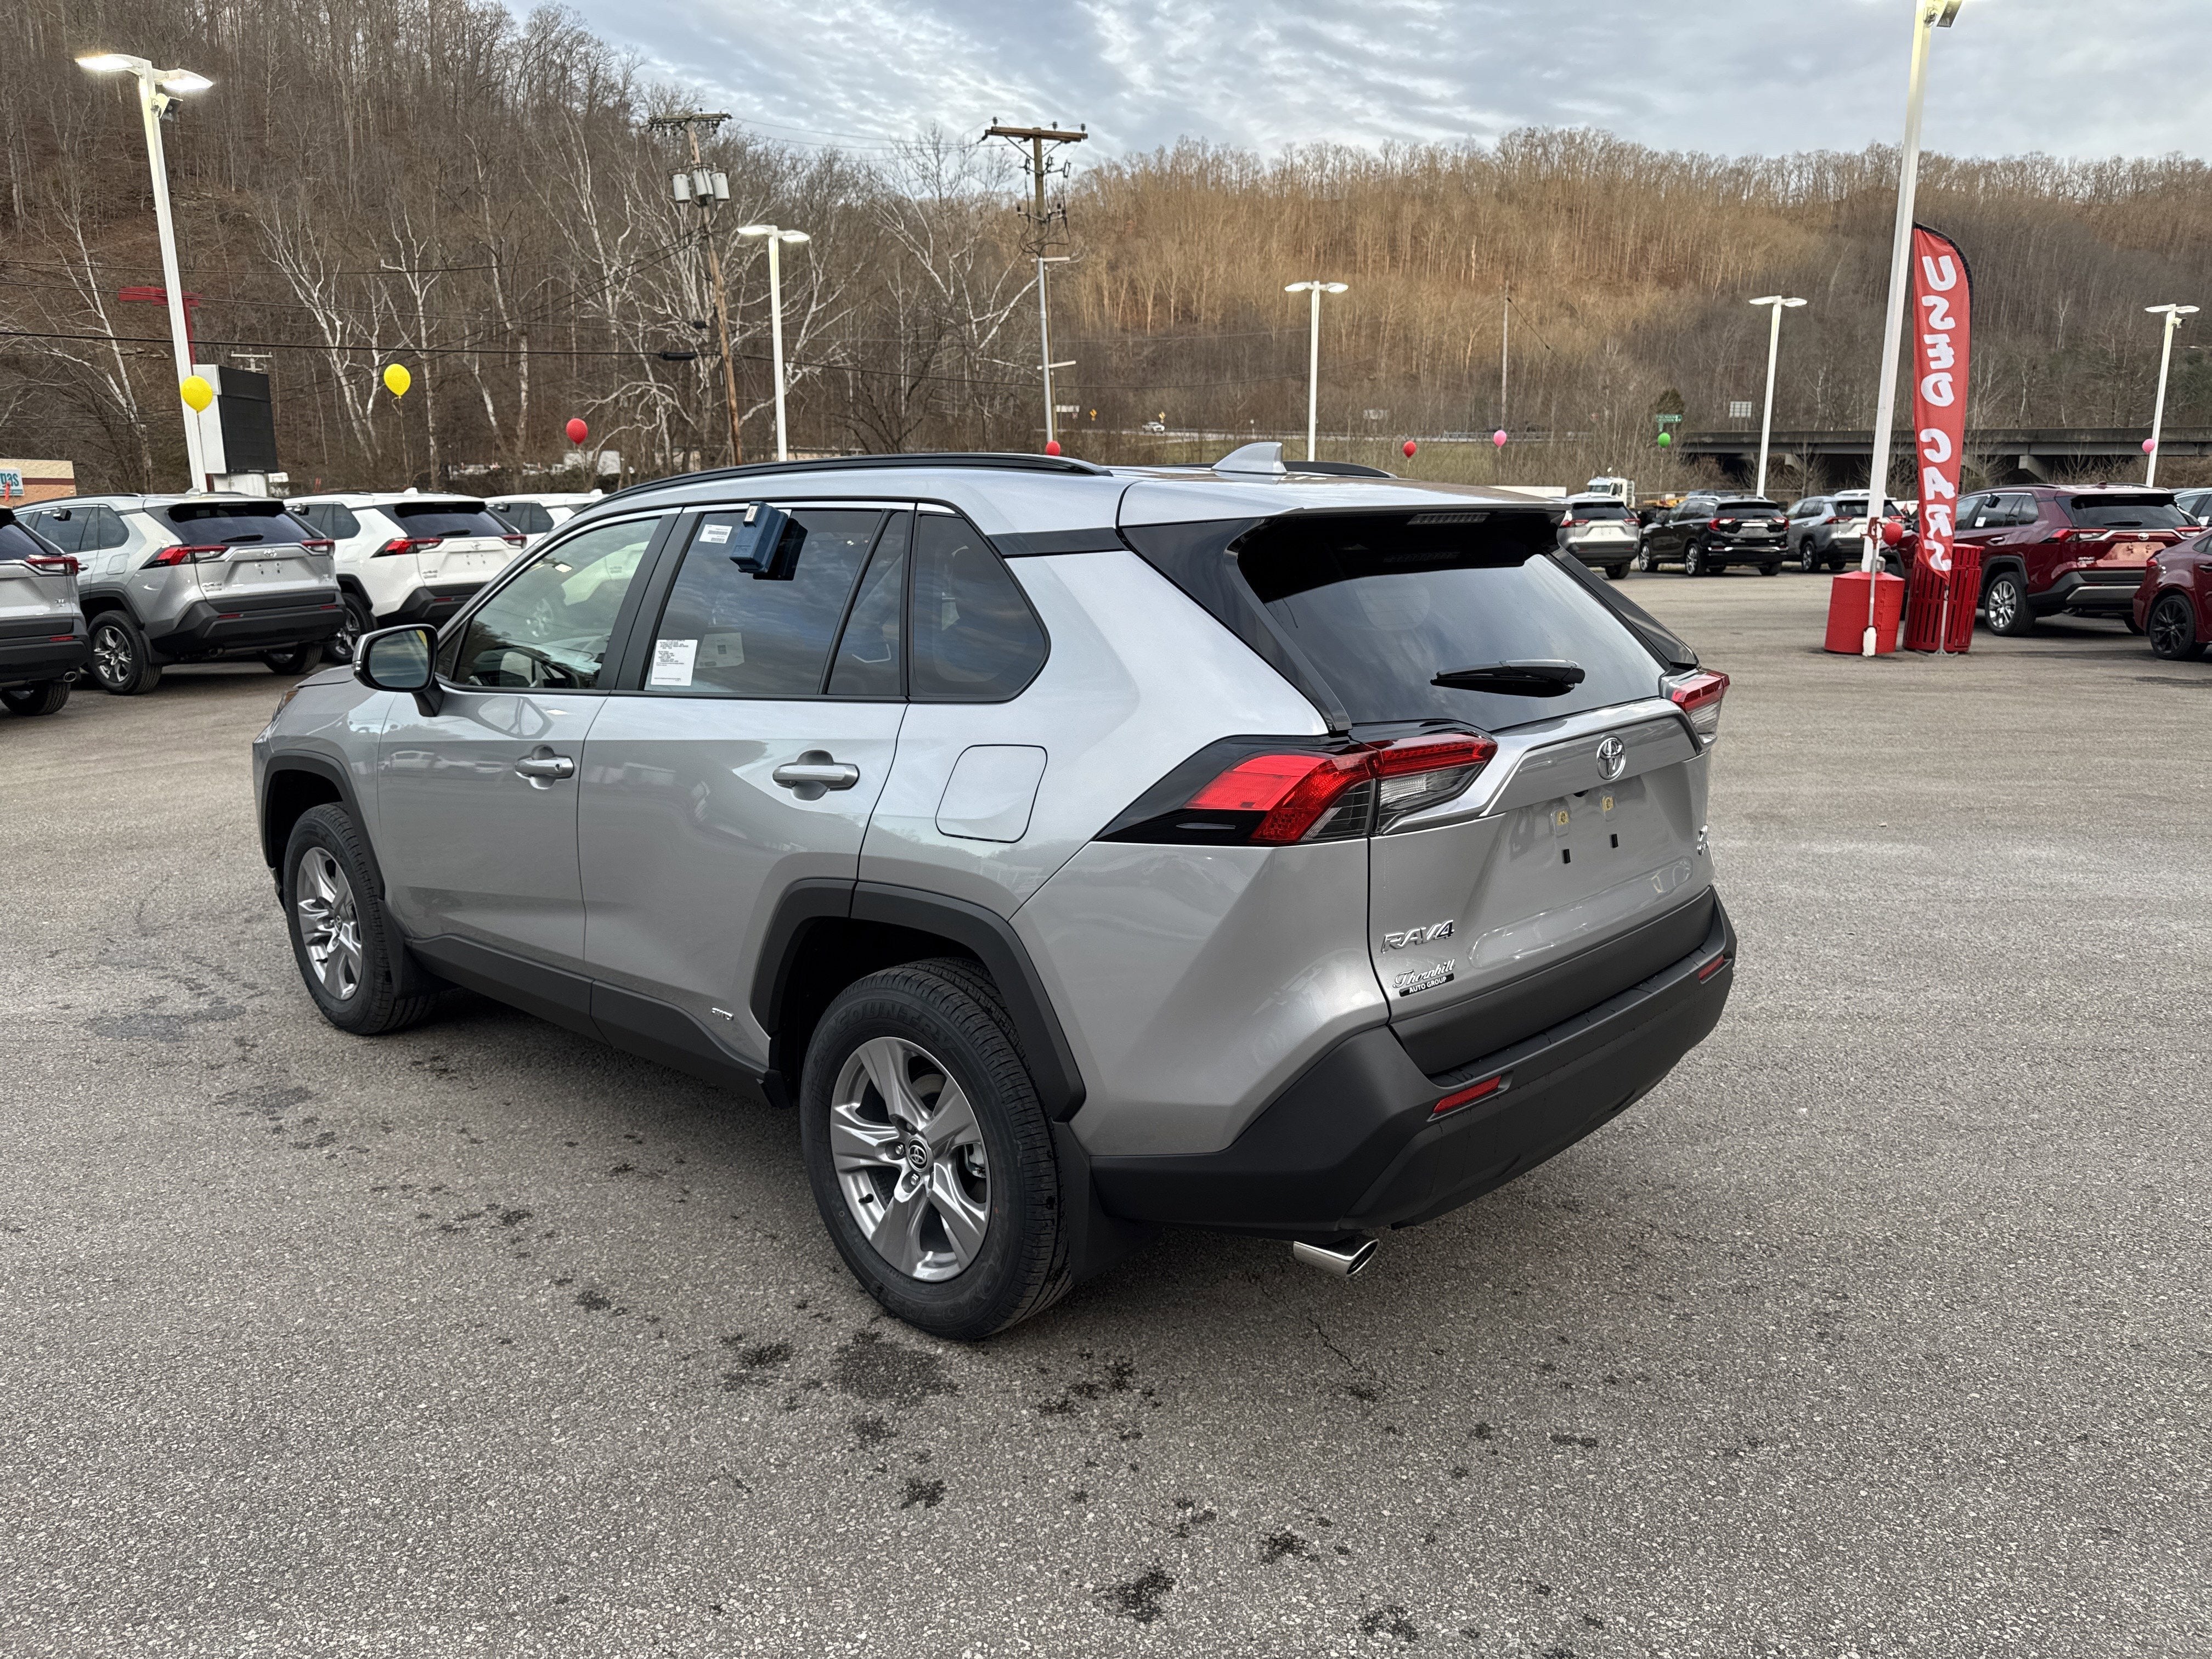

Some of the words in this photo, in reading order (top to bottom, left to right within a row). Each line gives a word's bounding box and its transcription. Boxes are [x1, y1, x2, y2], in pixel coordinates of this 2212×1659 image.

[0, 473, 19, 488] gas
[1381, 919, 1455, 954] RAV4
[1392, 958, 1455, 988] Thornhill
[1409, 983, 1426, 994] AUTO
[1426, 976, 1447, 988] GROUP
[834, 1002, 956, 1050] COUNTRY
